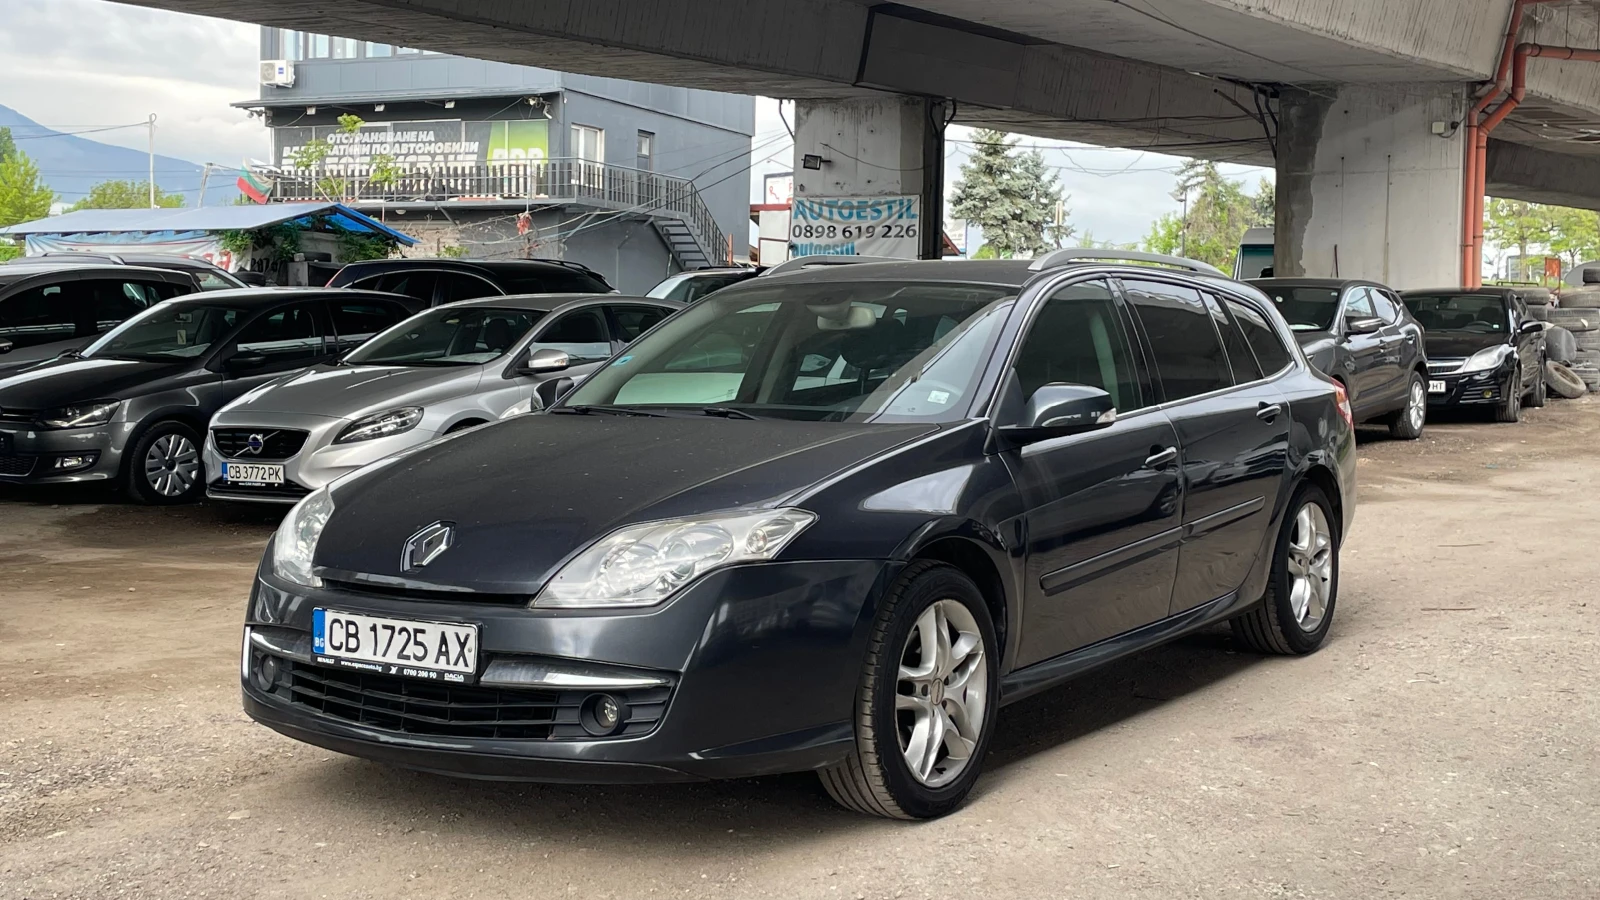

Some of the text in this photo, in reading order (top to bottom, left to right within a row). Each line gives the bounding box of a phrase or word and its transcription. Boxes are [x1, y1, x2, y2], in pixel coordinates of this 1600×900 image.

[418, 130, 435, 142] НА
[371, 143, 390, 155] ПО
[391, 141, 480, 155] АВТОМОБИЛИ
[794, 199, 918, 220] AUTOESTIL
[792, 224, 837, 239] 0898
[842, 224, 876, 239] 619
[881, 223, 917, 239] 226
[243, 466, 266, 480] 3772
[268, 467, 281, 481] PK
[314, 637, 325, 648] BG
[369, 623, 428, 662] 1725
